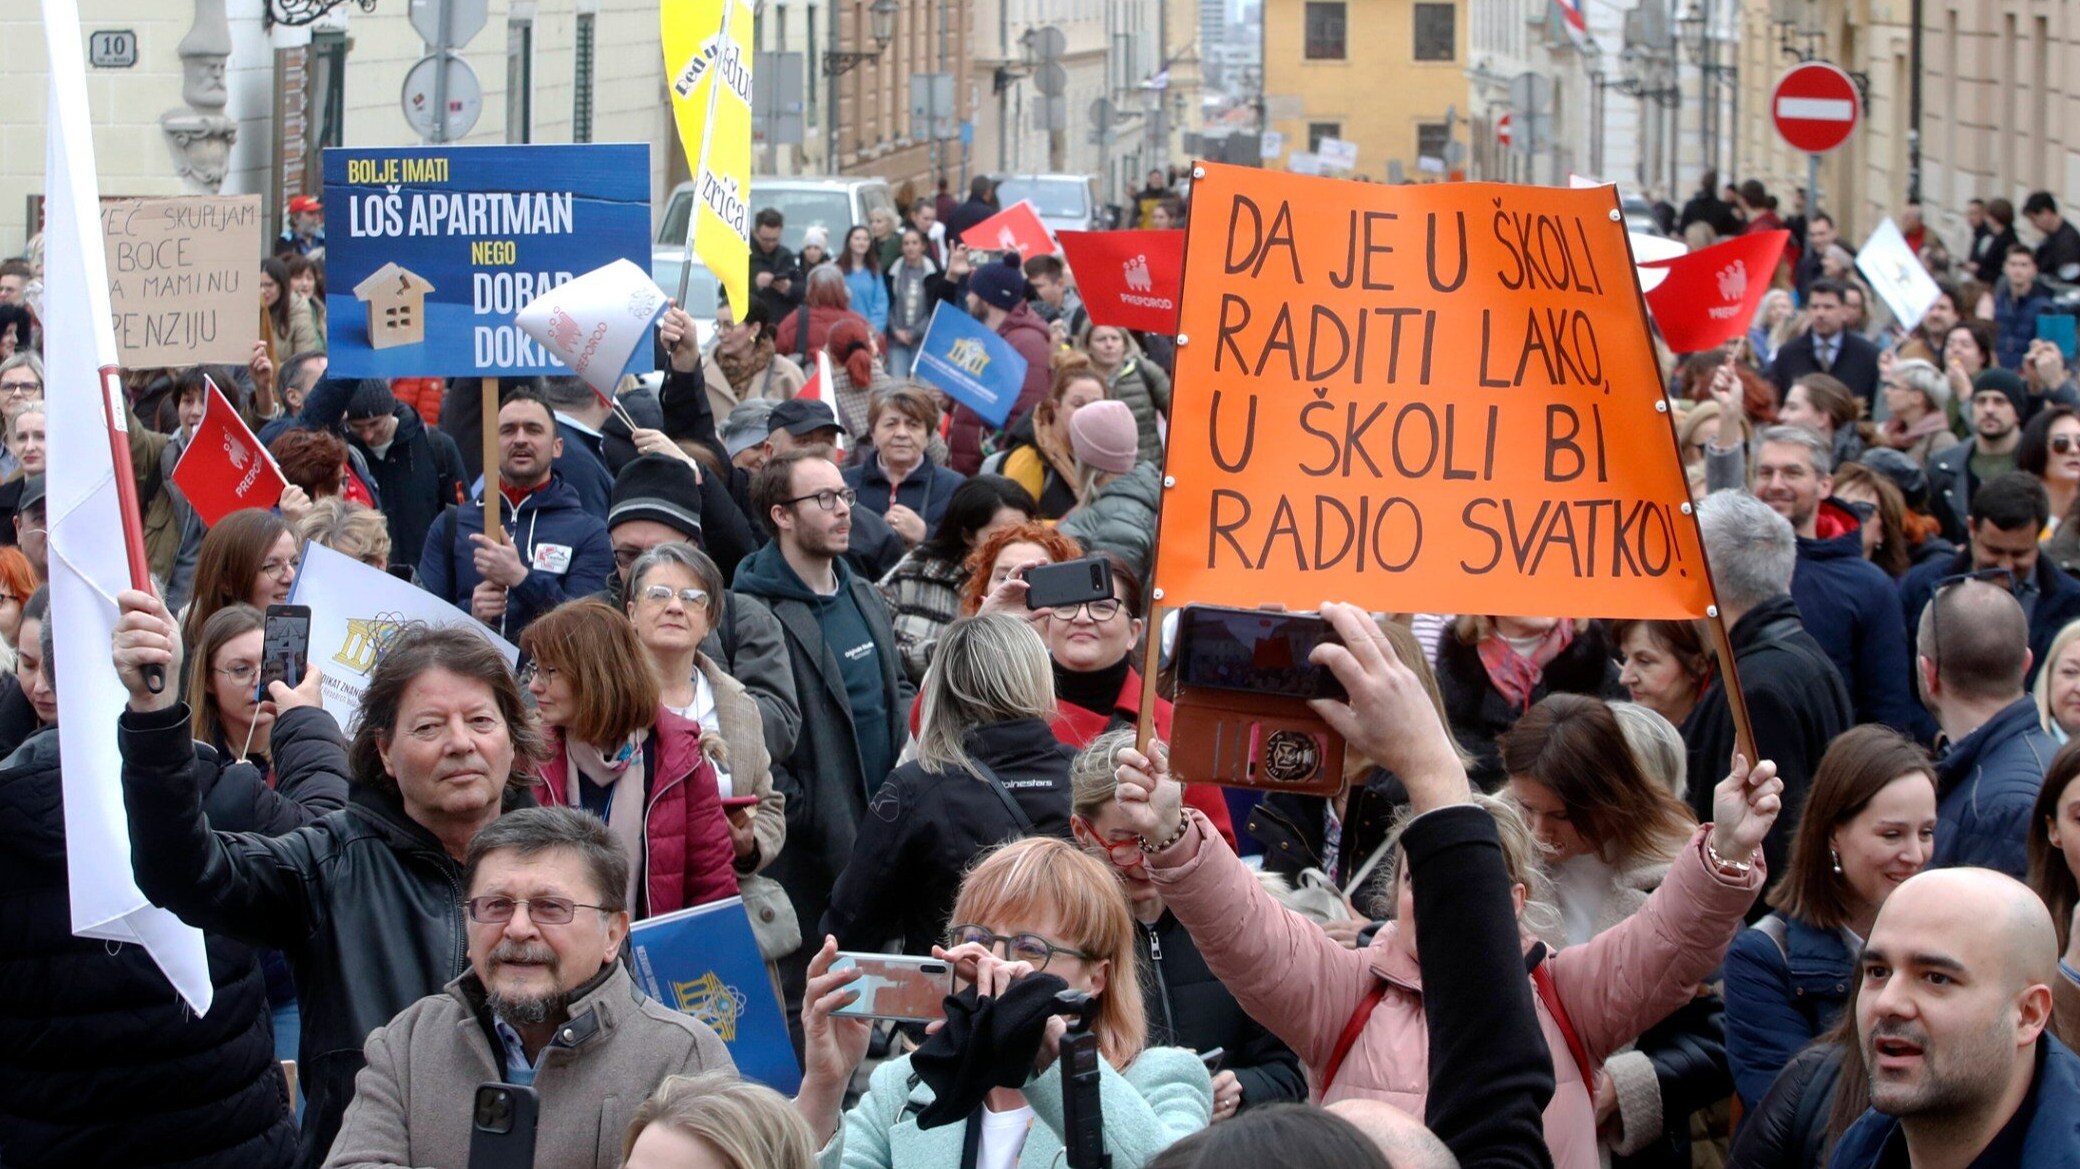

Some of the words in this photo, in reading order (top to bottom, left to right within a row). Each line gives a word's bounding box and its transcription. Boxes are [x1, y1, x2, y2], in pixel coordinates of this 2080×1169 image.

[103, 36, 125, 55] 10
[675, 57, 706, 97] Red
[348, 159, 399, 183] BOLJE
[402, 158, 449, 182] IMATI
[164, 204, 256, 232] SKUPLJAM
[350, 184, 404, 238] LOŠ
[408, 192, 573, 236] APARTMAN
[117, 238, 193, 272] BOCE
[471, 241, 516, 265] NEGO
[1226, 194, 1302, 283] DA
[1330, 211, 1396, 291] JE
[1427, 212, 1468, 293] U
[1494, 198, 1602, 295] ŠKOLI
[143, 270, 239, 298] MAMINU
[1120, 292, 1173, 309] PREPOROD
[575, 321, 608, 374] REPOROD
[1214, 294, 1435, 384] RADITI
[1481, 306, 1607, 396] LAKO,
[1210, 391, 1258, 473] U
[1299, 387, 1498, 481] ŠKOLI
[1545, 403, 1607, 483] BI
[1209, 490, 1422, 572] RADIO
[1462, 499, 1686, 578] SVATKO!
